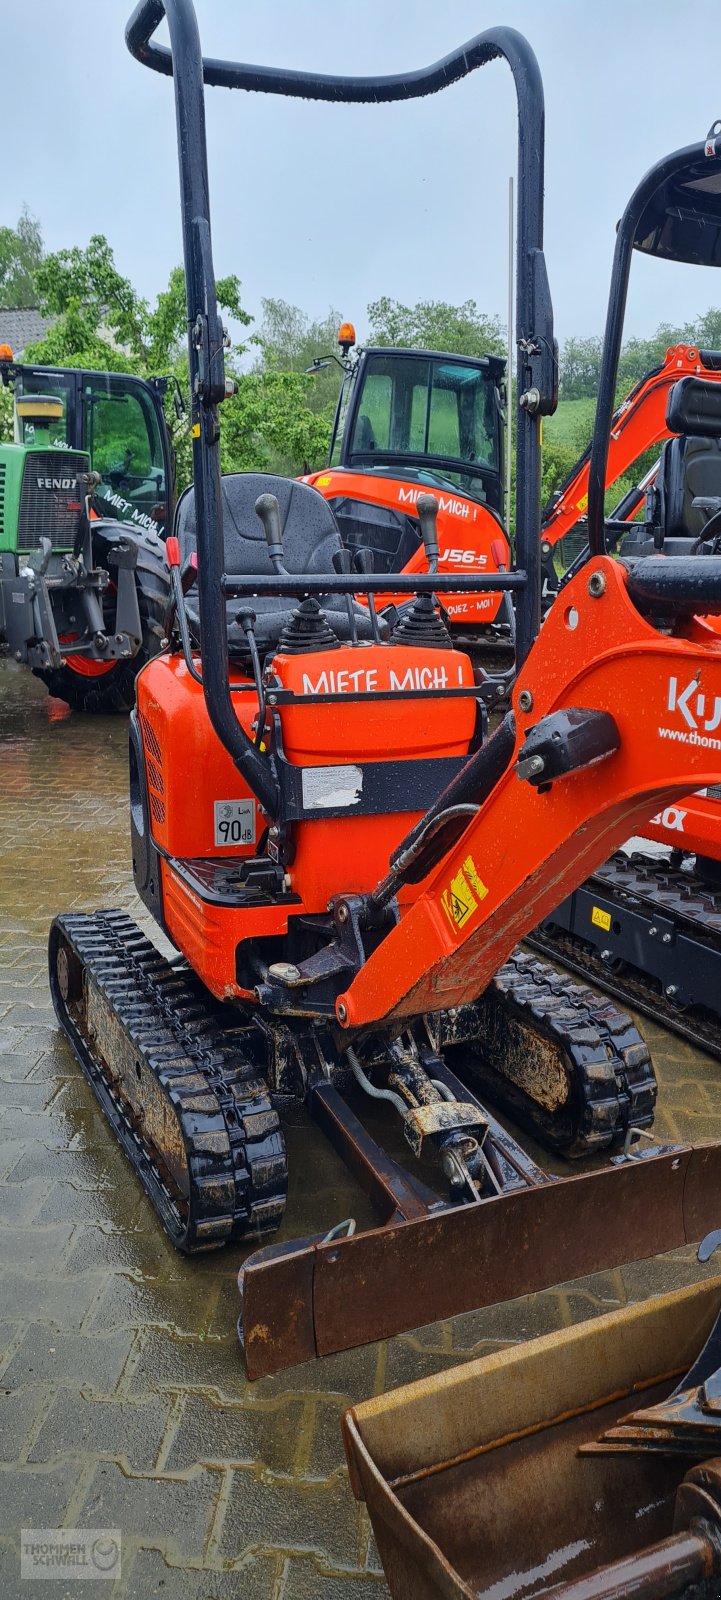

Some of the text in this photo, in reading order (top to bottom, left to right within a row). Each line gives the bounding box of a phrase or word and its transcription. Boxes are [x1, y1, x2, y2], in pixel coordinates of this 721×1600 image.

[37, 478, 77, 489] FENDT
[103, 489, 133, 513] MIET
[131, 508, 158, 530] MICH
[438, 497, 470, 518] MICH
[302, 669, 378, 695] MIETE
[389, 666, 449, 692] MICH
[658, 727, 721, 750] www.thom
